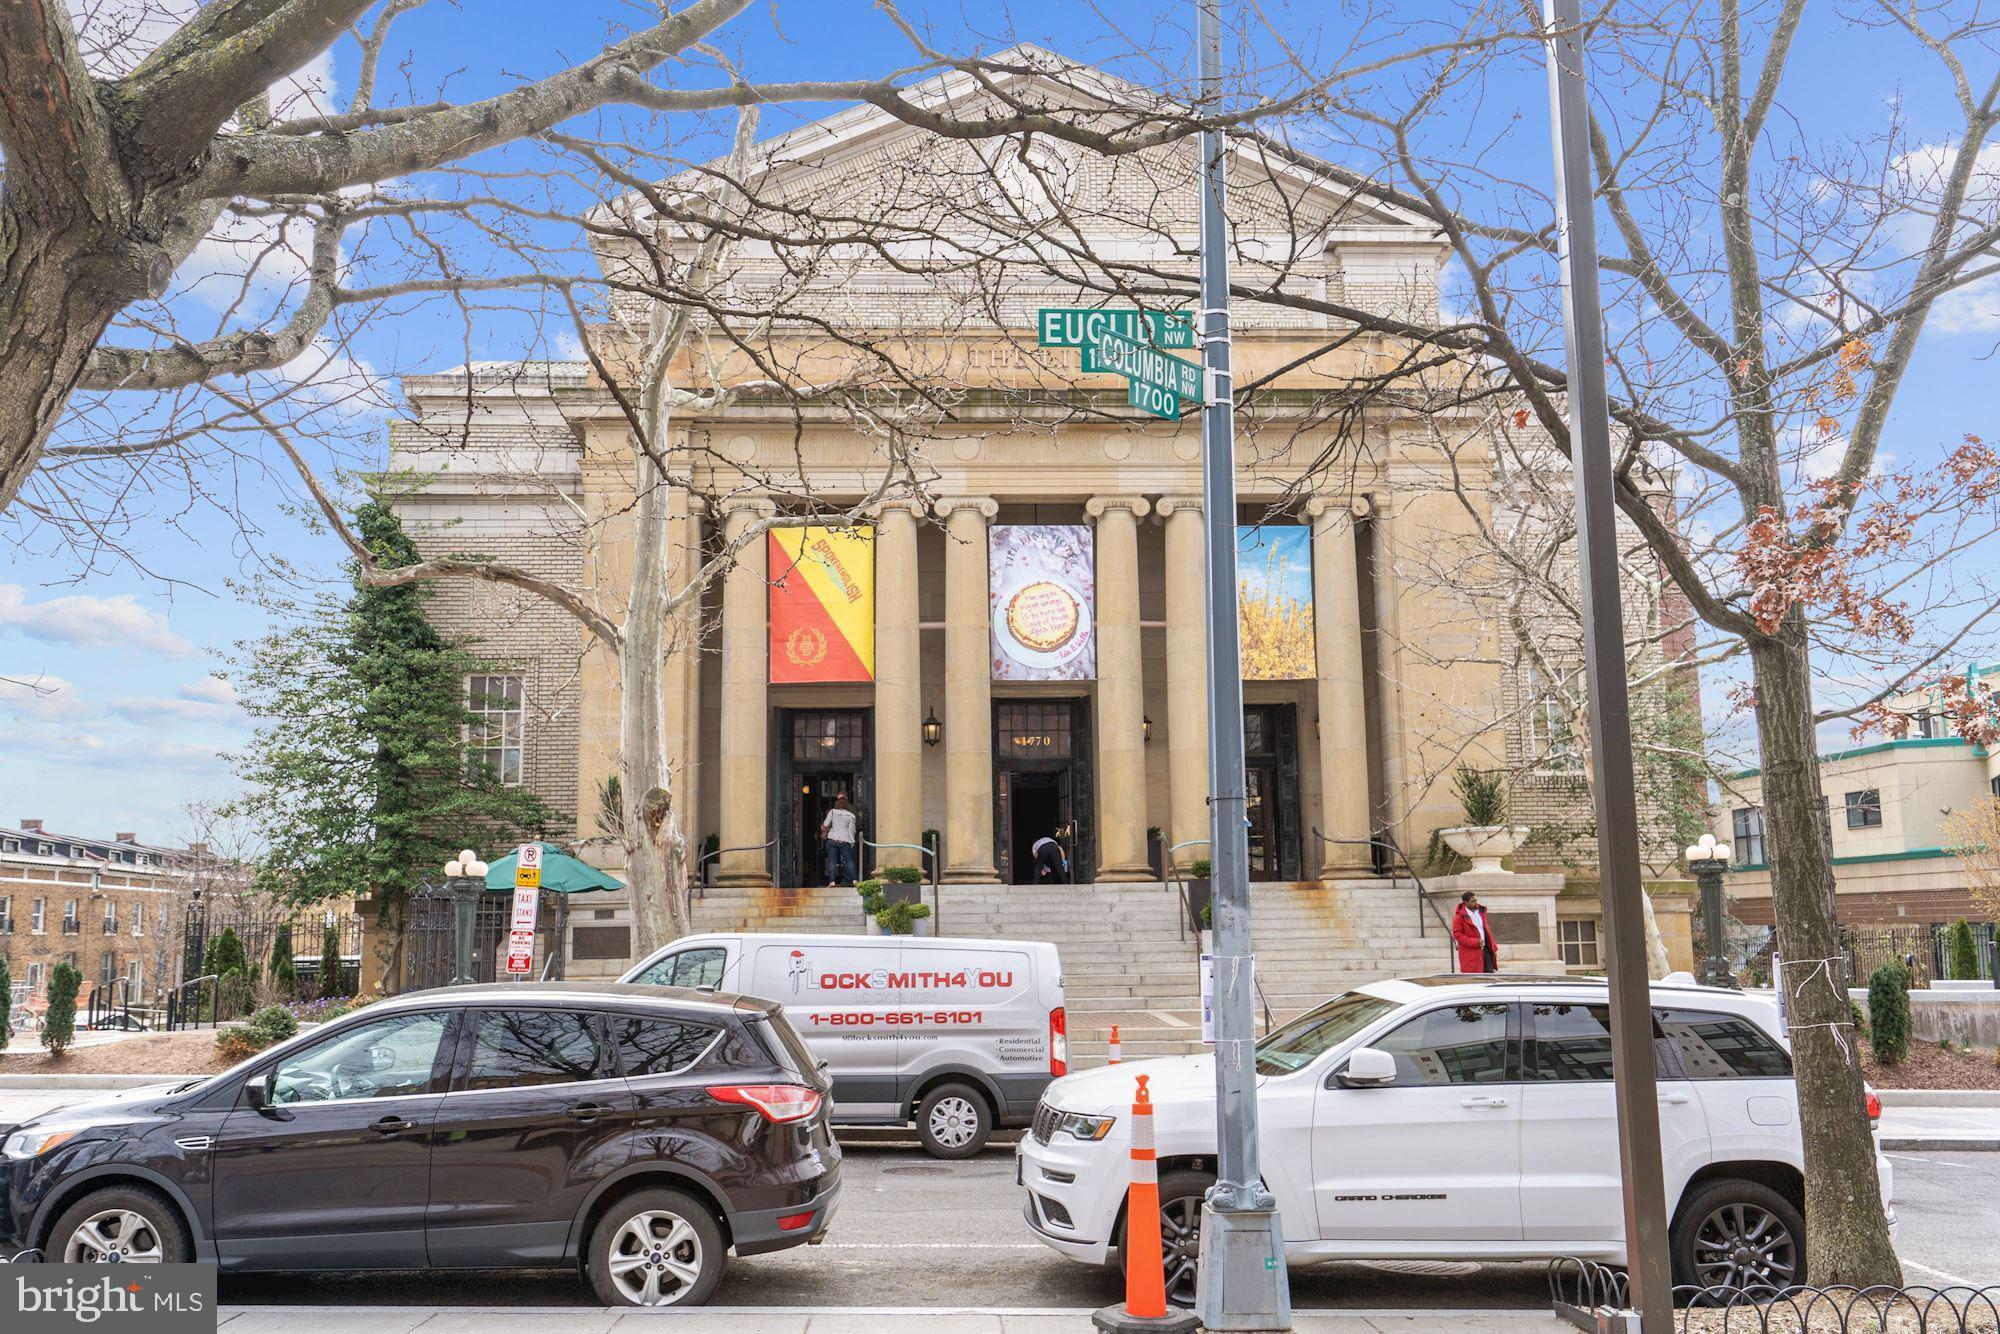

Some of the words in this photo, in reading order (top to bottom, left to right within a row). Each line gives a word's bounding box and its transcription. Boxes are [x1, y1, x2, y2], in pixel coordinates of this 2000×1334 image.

[1164, 315, 1185, 329] ST
[1164, 331, 1185, 345] NW
[1102, 334, 1177, 391] COLUMBIA
[1181, 365, 1196, 382] RD
[1181, 381, 1196, 397] NW
[1134, 382, 1175, 416] 1700
[1005, 544, 1021, 569] THE
[1019, 532, 1048, 545] LINE
[1022, 736, 1051, 746] 1770
[517, 893, 532, 904] TAXI
[515, 908, 533, 917] STAND
[806, 968, 1013, 990] LOCKSMITH4YOU
[809, 1011, 983, 1026] 1-800-661-6101
[999, 1037, 1041, 1045] Residential
[998, 1046, 1045, 1054] Commercial
[998, 1054, 1043, 1062] Automotive
[1334, 1194, 1378, 1202] GRAND
[1381, 1193, 1447, 1201] CHEROKEE
